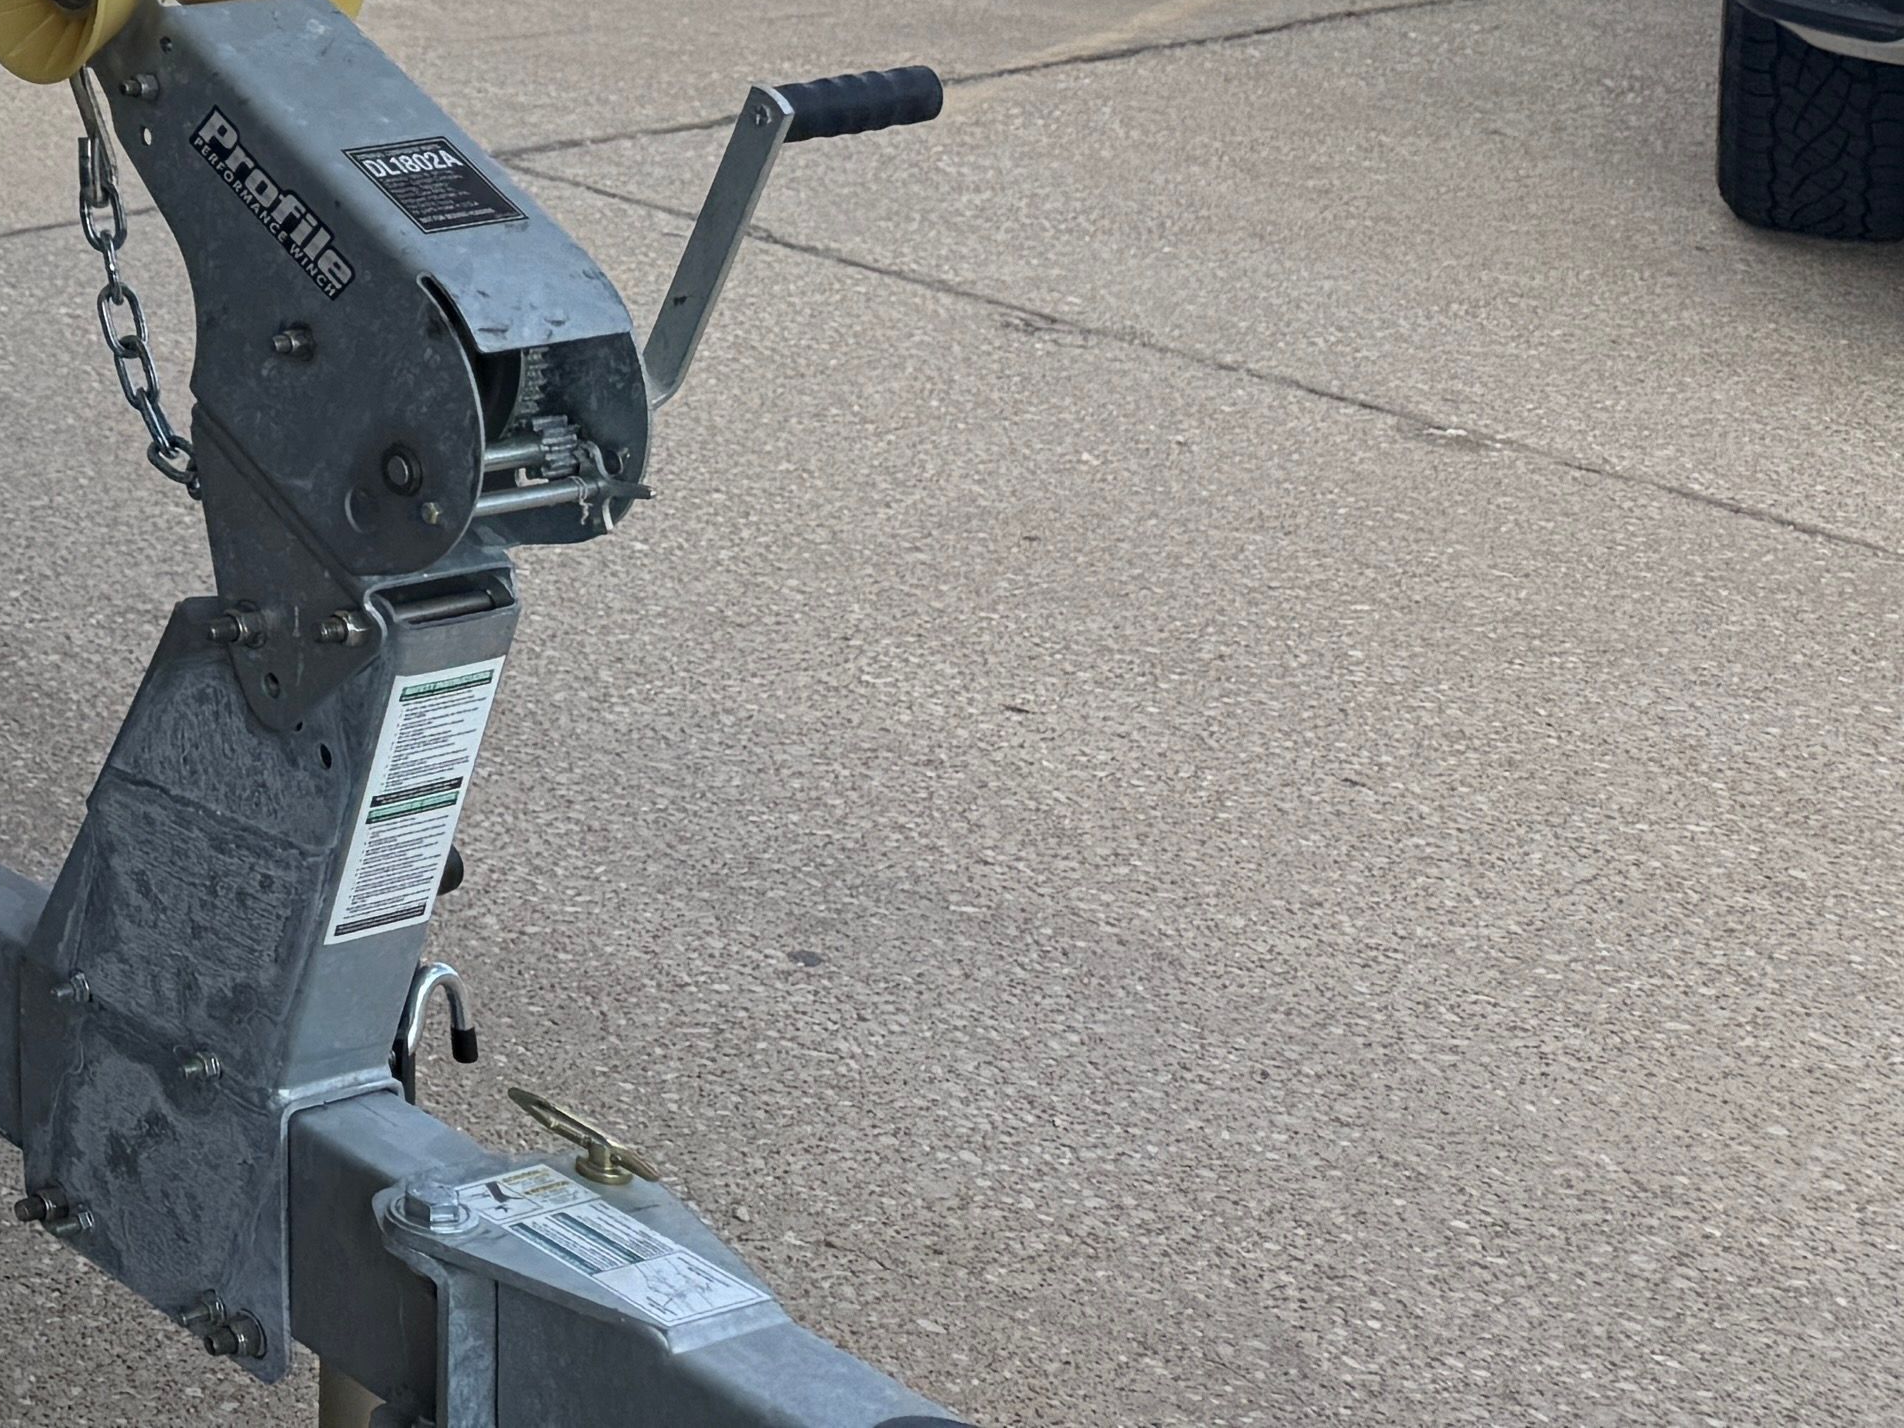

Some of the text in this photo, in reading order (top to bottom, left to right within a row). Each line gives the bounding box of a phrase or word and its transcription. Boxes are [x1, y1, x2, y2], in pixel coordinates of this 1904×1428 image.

[193, 136, 336, 297] PERFORMANCE WINCH
[198, 109, 353, 290] Profile
[362, 150, 464, 178] DL1802A
